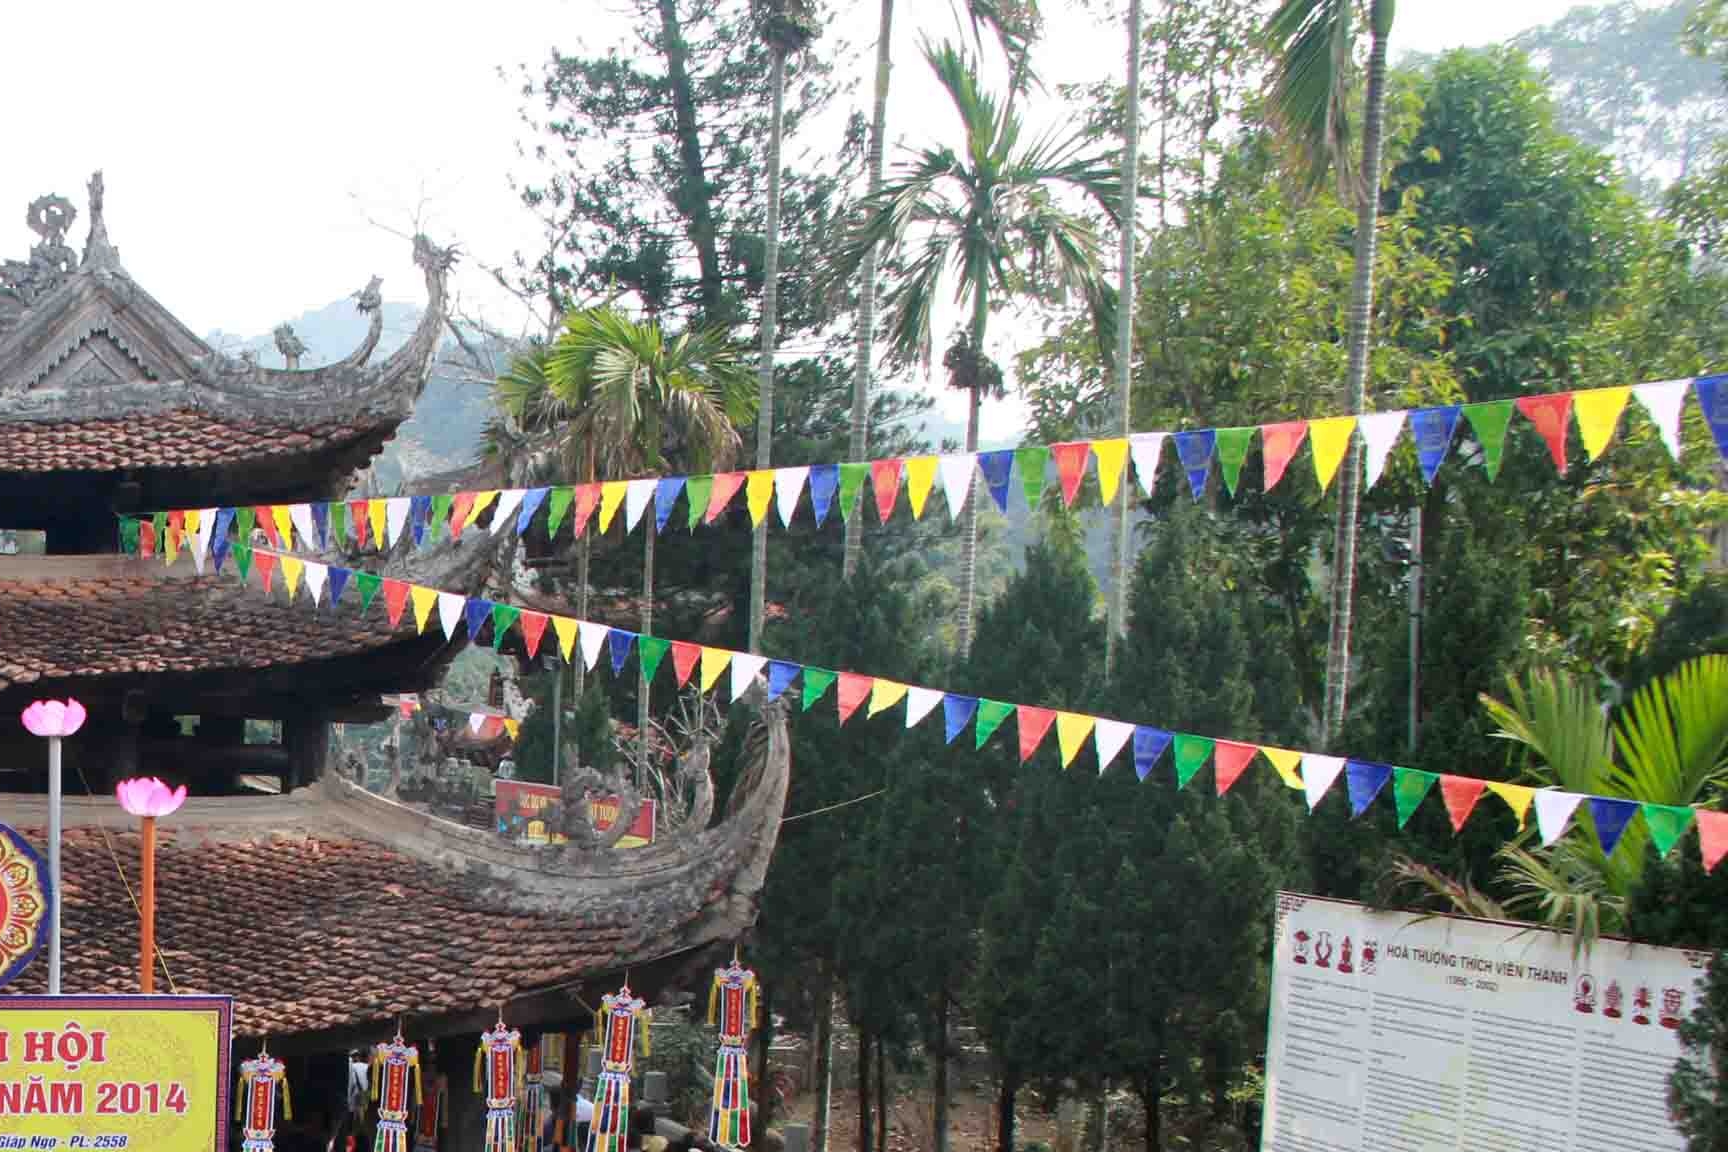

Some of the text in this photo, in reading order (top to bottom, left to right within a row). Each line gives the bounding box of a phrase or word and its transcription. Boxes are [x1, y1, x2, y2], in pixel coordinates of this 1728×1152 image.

[23, 1021, 108, 1069] HỘI
[95, 1082, 188, 1115] 2014
[93, 1135, 128, 1148] 2558
